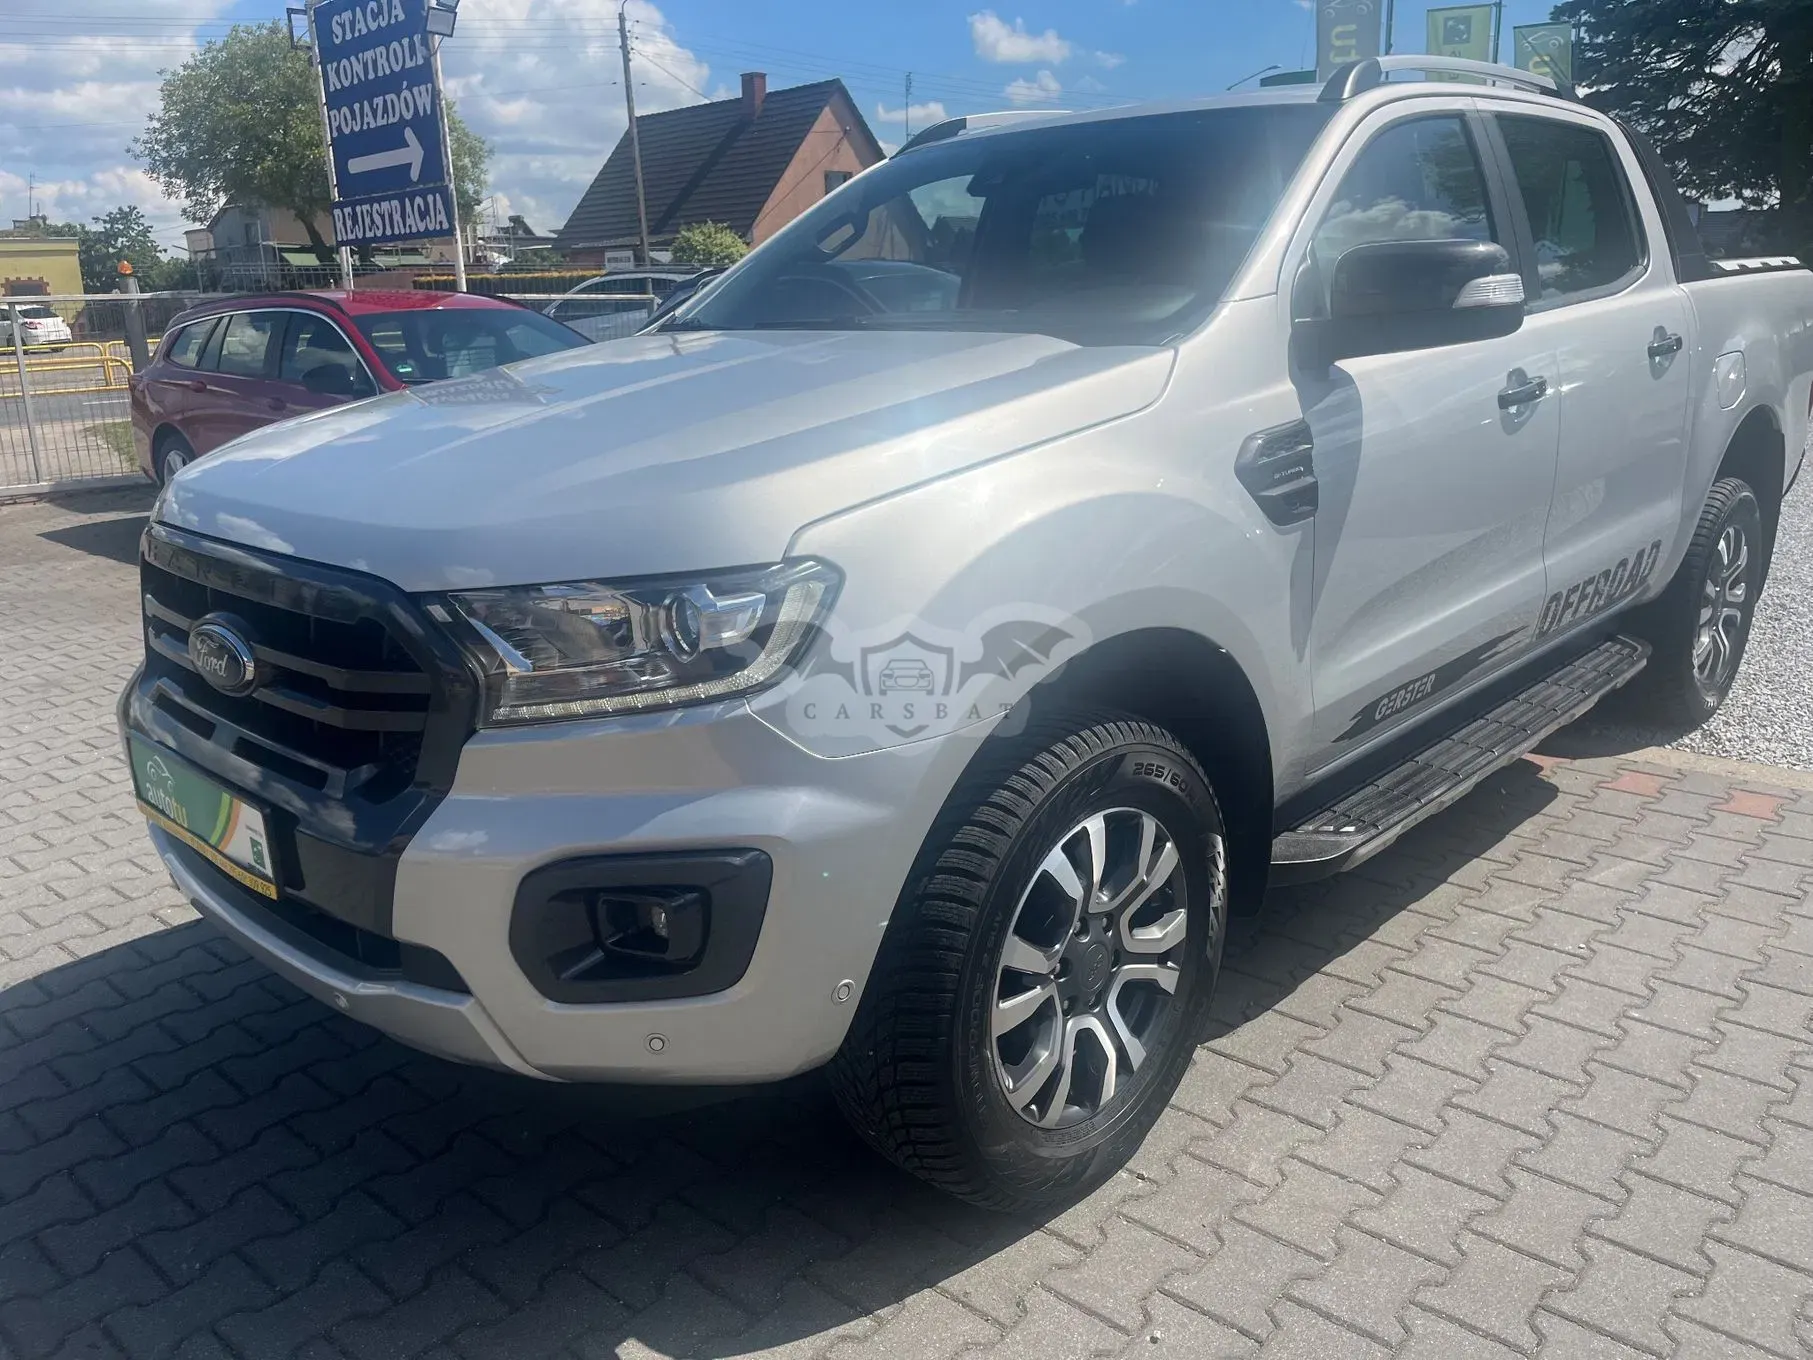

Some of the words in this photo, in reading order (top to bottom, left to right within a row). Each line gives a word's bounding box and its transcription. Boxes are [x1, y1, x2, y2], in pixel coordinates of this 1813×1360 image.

[331, 0, 406, 45] STACJA
[329, 80, 433, 138] POJAZDÓW
[333, 193, 449, 241] REJESTRACJA
[1536, 539, 1662, 641] OFFROAD
[196, 635, 229, 677] Ford
[1374, 673, 1436, 721] GERSTER
